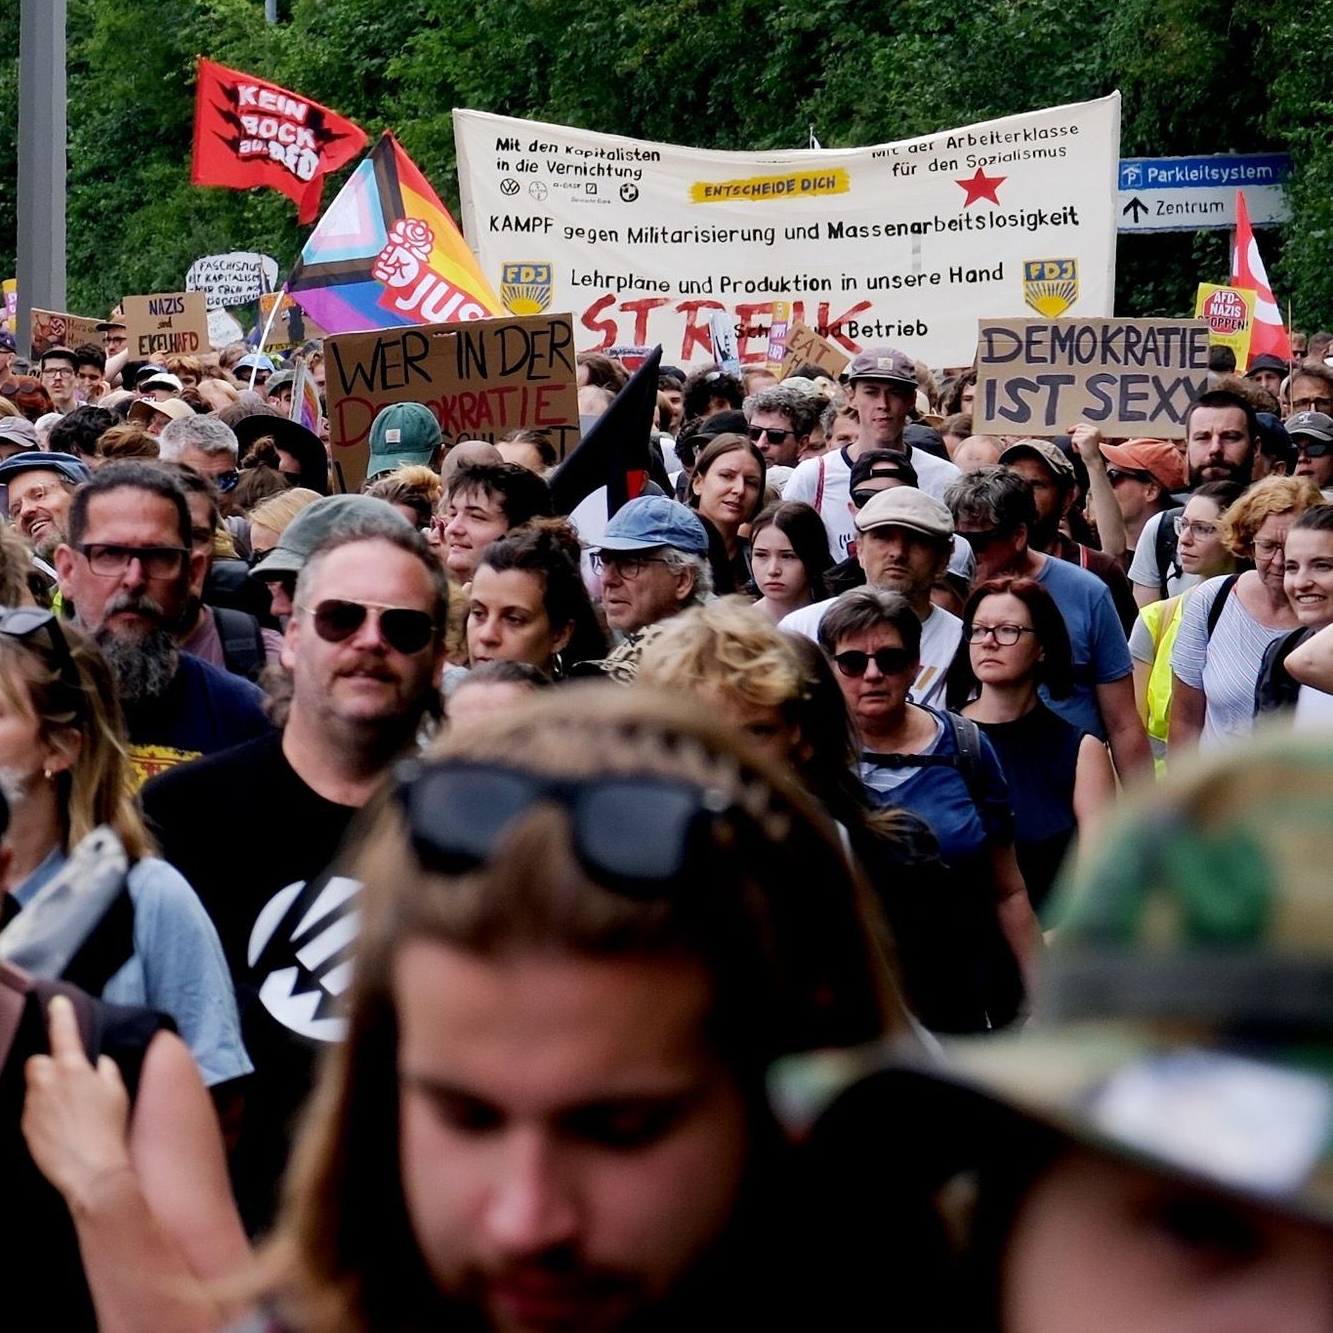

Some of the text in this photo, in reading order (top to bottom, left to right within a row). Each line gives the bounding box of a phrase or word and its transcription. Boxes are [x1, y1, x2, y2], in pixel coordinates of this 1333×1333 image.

[237, 85, 308, 121] KEIN
[240, 115, 316, 149] BOCK
[946, 124, 1079, 150] Arbeiterklasse
[239, 139, 268, 154] au
[495, 138, 521, 153] Mit
[528, 140, 558, 154] den
[496, 158, 643, 180] in die Vernichtung
[892, 145, 1067, 177] für den Sozialismus
[1148, 164, 1273, 183] Parkleitsystem
[704, 175, 836, 198] ENTSCHEIDE DICH
[1156, 200, 1224, 216] Zentrum
[490, 206, 1080, 246] KAMPF gegen Militarisierung und Massenarbeitslosigkeit
[505, 267, 549, 283] FDJ
[571, 262, 1004, 294] Lehrpläne und Produktion in unsere Hand
[1026, 260, 1075, 281] FDJ
[149, 297, 185, 316] NAZIS
[1213, 291, 1240, 304] AFD-
[1209, 303, 1241, 318] NAZIS
[849, 319, 928, 339] Betrieb
[1198, 315, 1249, 332] OPPEN!
[790, 329, 831, 363] EAT
[981, 325, 1210, 369] DEMOKRATIE
[331, 320, 573, 396] WER IN DER
[985, 373, 1208, 426] IST SEXY
